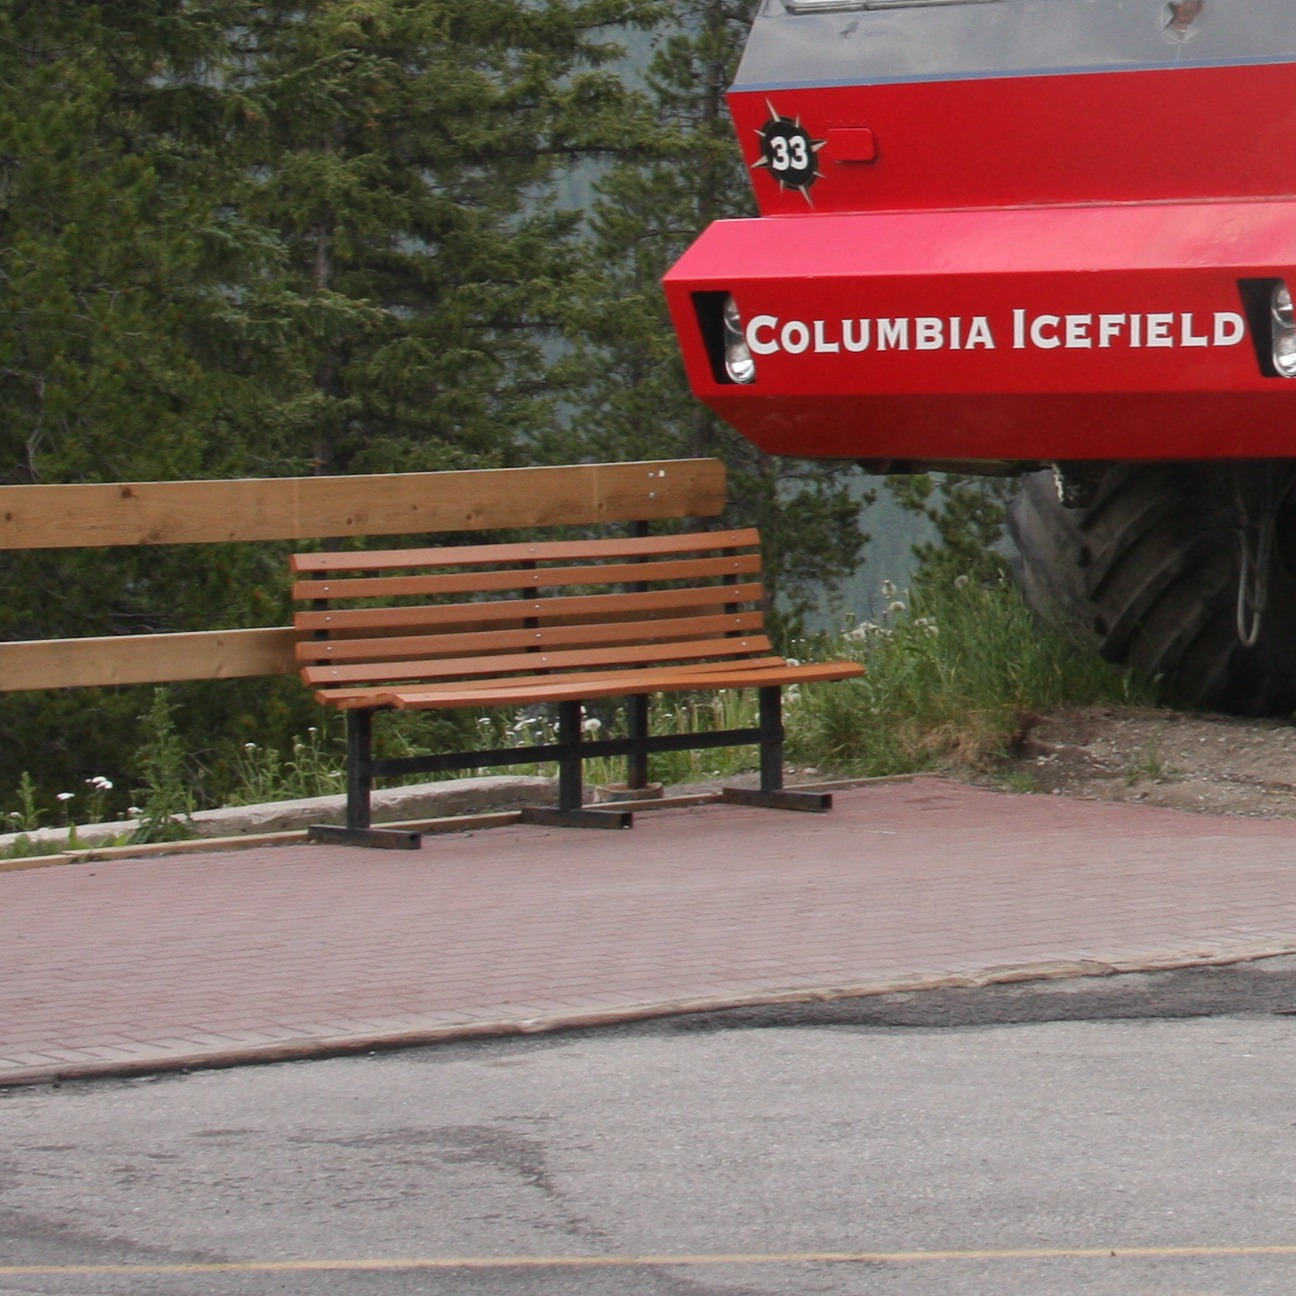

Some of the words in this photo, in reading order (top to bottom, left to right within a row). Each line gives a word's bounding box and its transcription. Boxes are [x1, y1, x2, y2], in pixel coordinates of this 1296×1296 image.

[769, 135, 809, 172] 33
[745, 313, 996, 355] COLUMBIA
[1012, 308, 1246, 349] ICEFIELD
